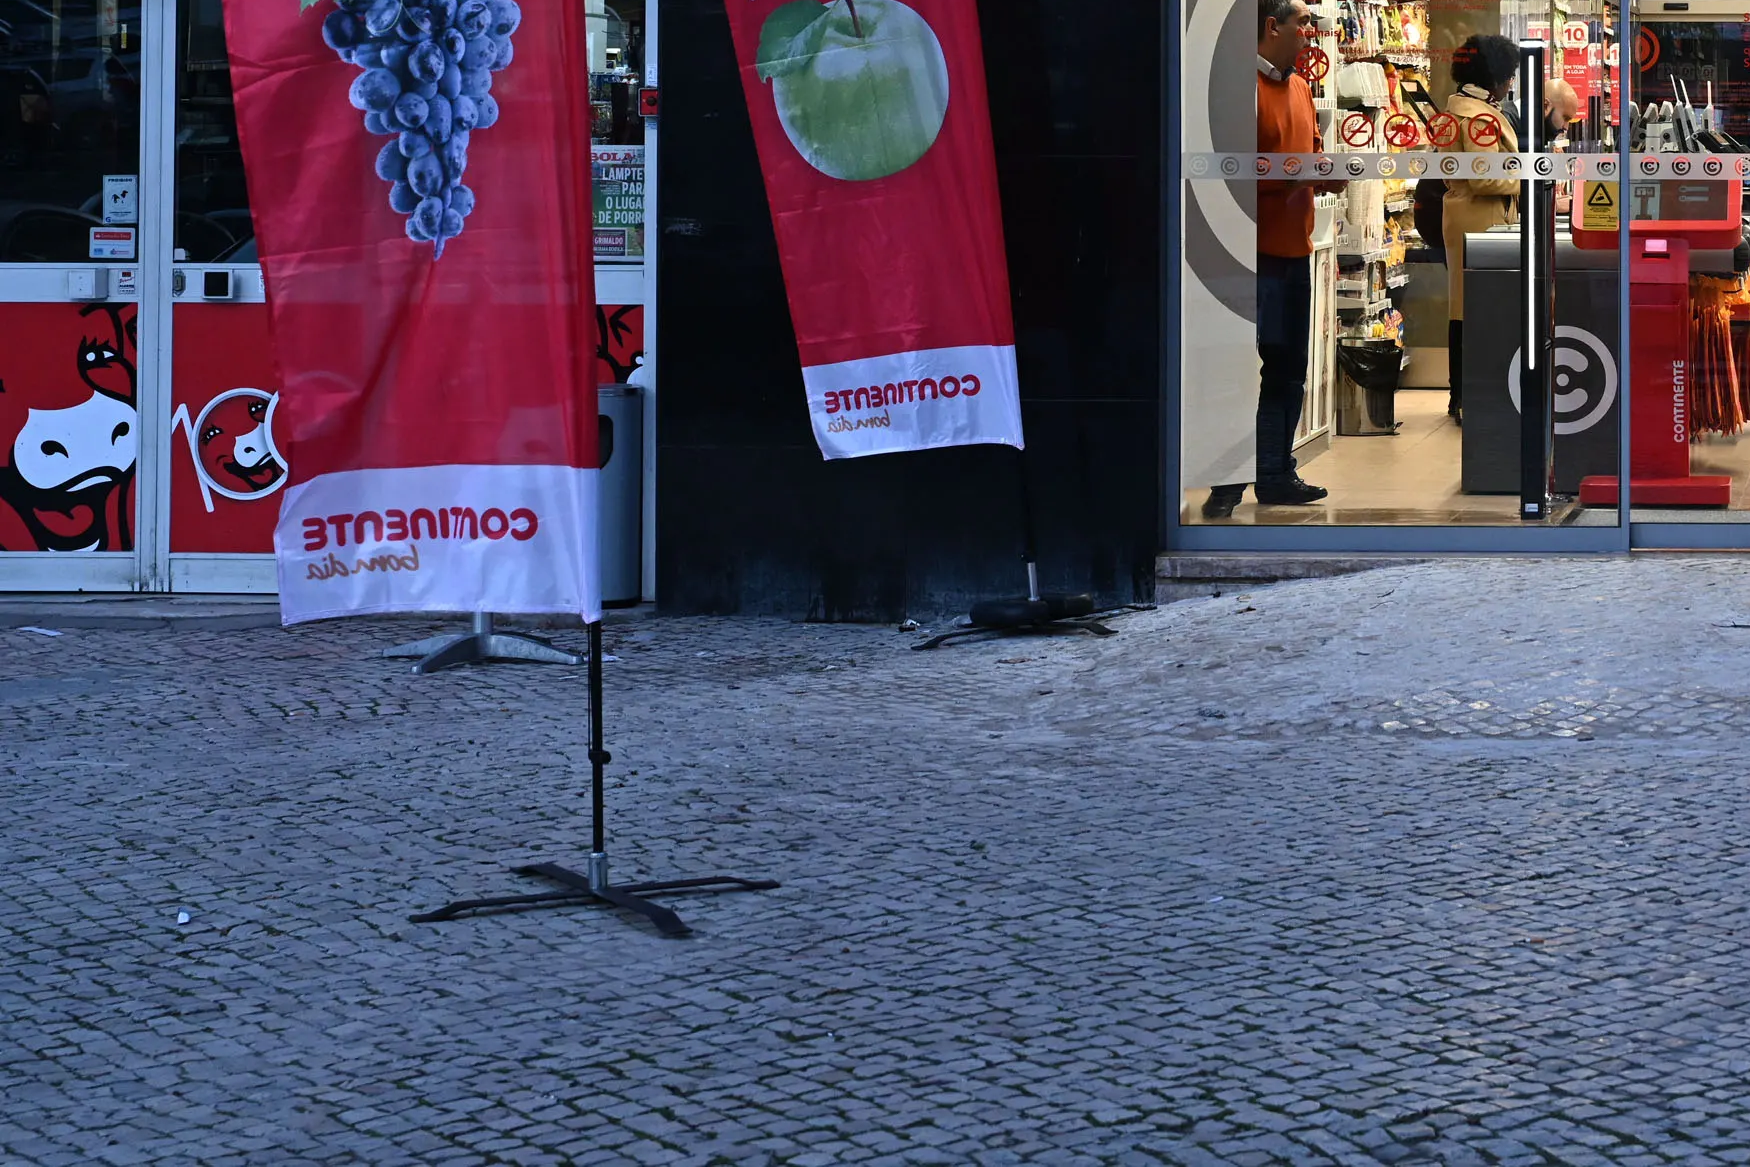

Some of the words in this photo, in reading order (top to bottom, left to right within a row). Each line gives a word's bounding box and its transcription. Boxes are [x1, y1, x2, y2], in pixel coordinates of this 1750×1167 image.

[602, 168, 644, 180] LAMPTE
[606, 196, 613, 209] O
[615, 196, 644, 209] LUGA
[599, 211, 612, 224] DE
[594, 236, 623, 245] GRIMALDO
[1673, 360, 1684, 442] CONTINENTE
